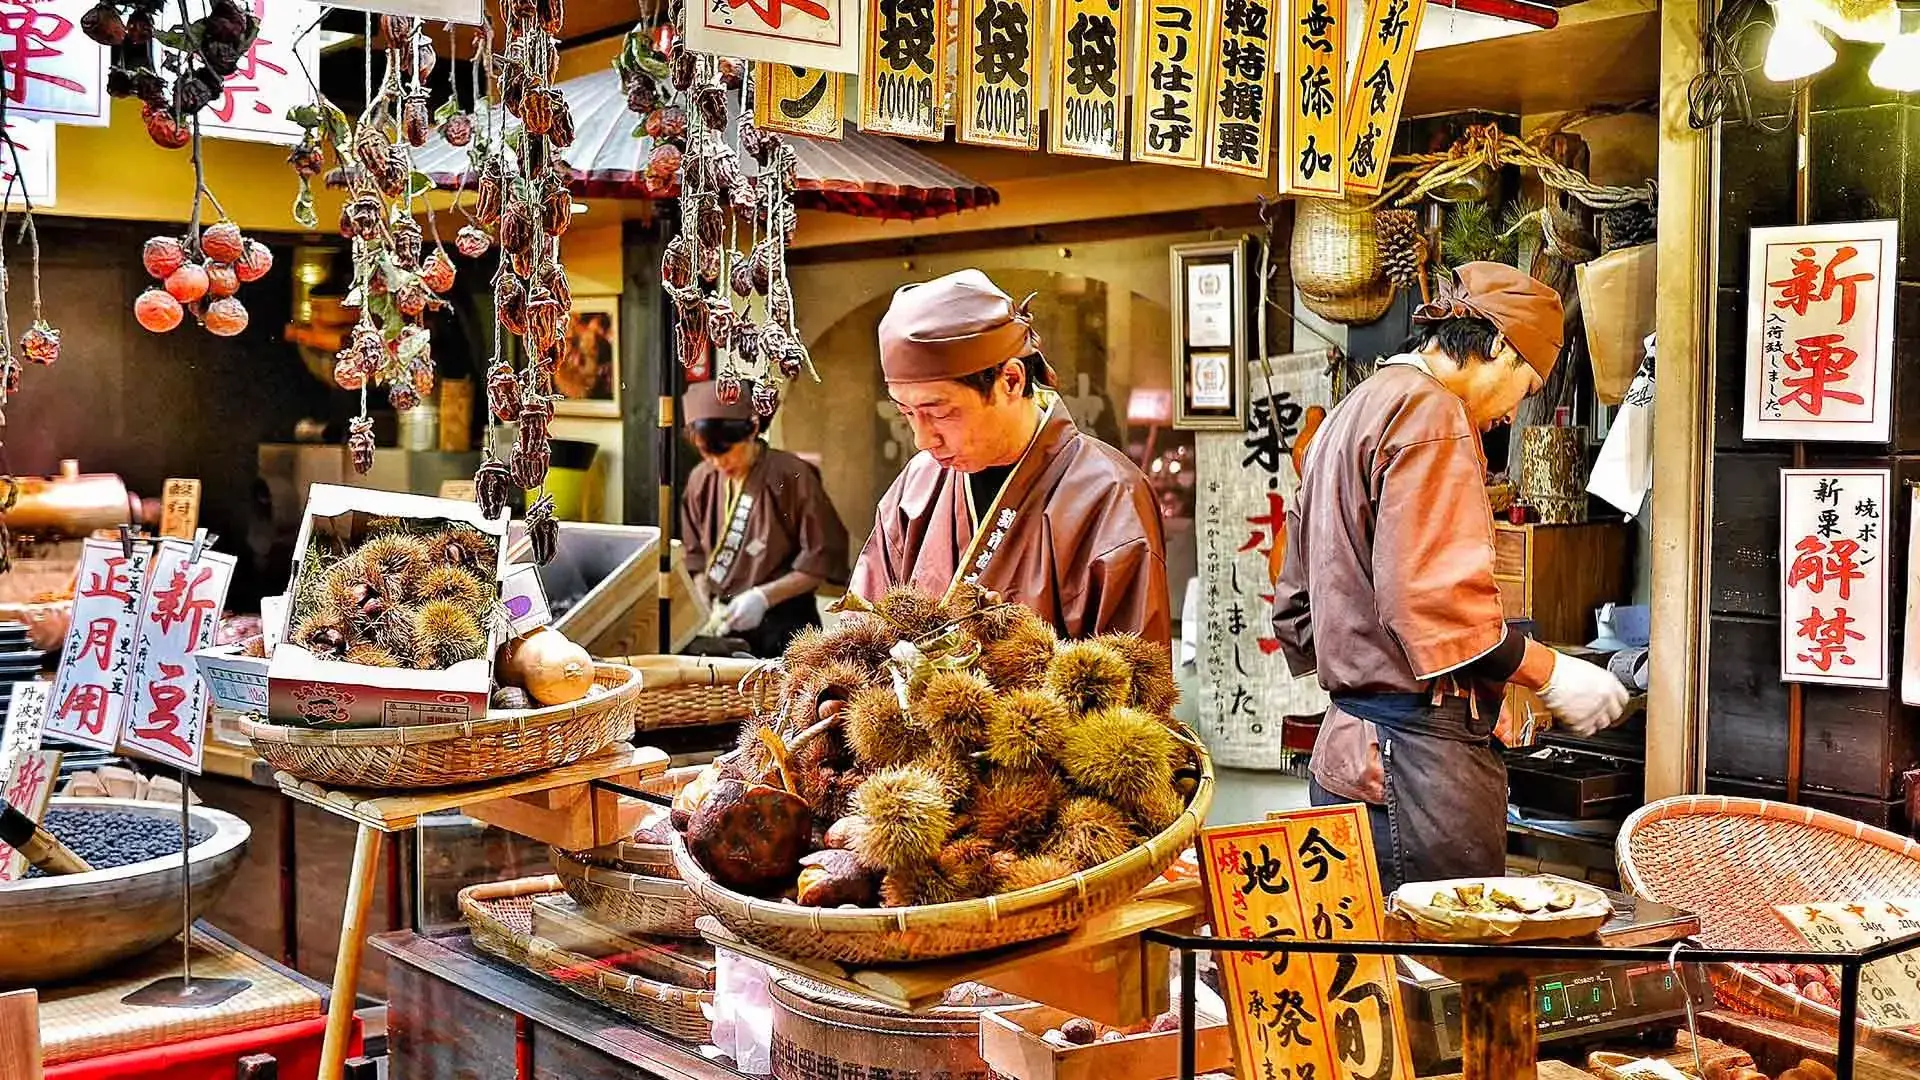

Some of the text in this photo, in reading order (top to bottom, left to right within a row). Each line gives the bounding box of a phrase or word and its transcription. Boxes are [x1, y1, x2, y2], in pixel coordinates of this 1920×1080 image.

[975, 0, 1030, 87] 袋
[976, 85, 1029, 138] 2000円
[1148, 6, 1194, 153] コリ仕上げ
[1299, 0, 1336, 180] 無添加
[1347, 0, 1410, 178] 新食感
[1065, 97, 1116, 147] 3000円
[1765, 313, 1787, 418] 入荷致しました。
[1768, 246, 1876, 416] 新栗
[1813, 478, 1844, 539] 新栗
[1855, 497, 1881, 566] 焼ポン
[59, 556, 135, 736] 正月用
[133, 560, 217, 759] 新豆
[1788, 535, 1866, 672] 解禁
